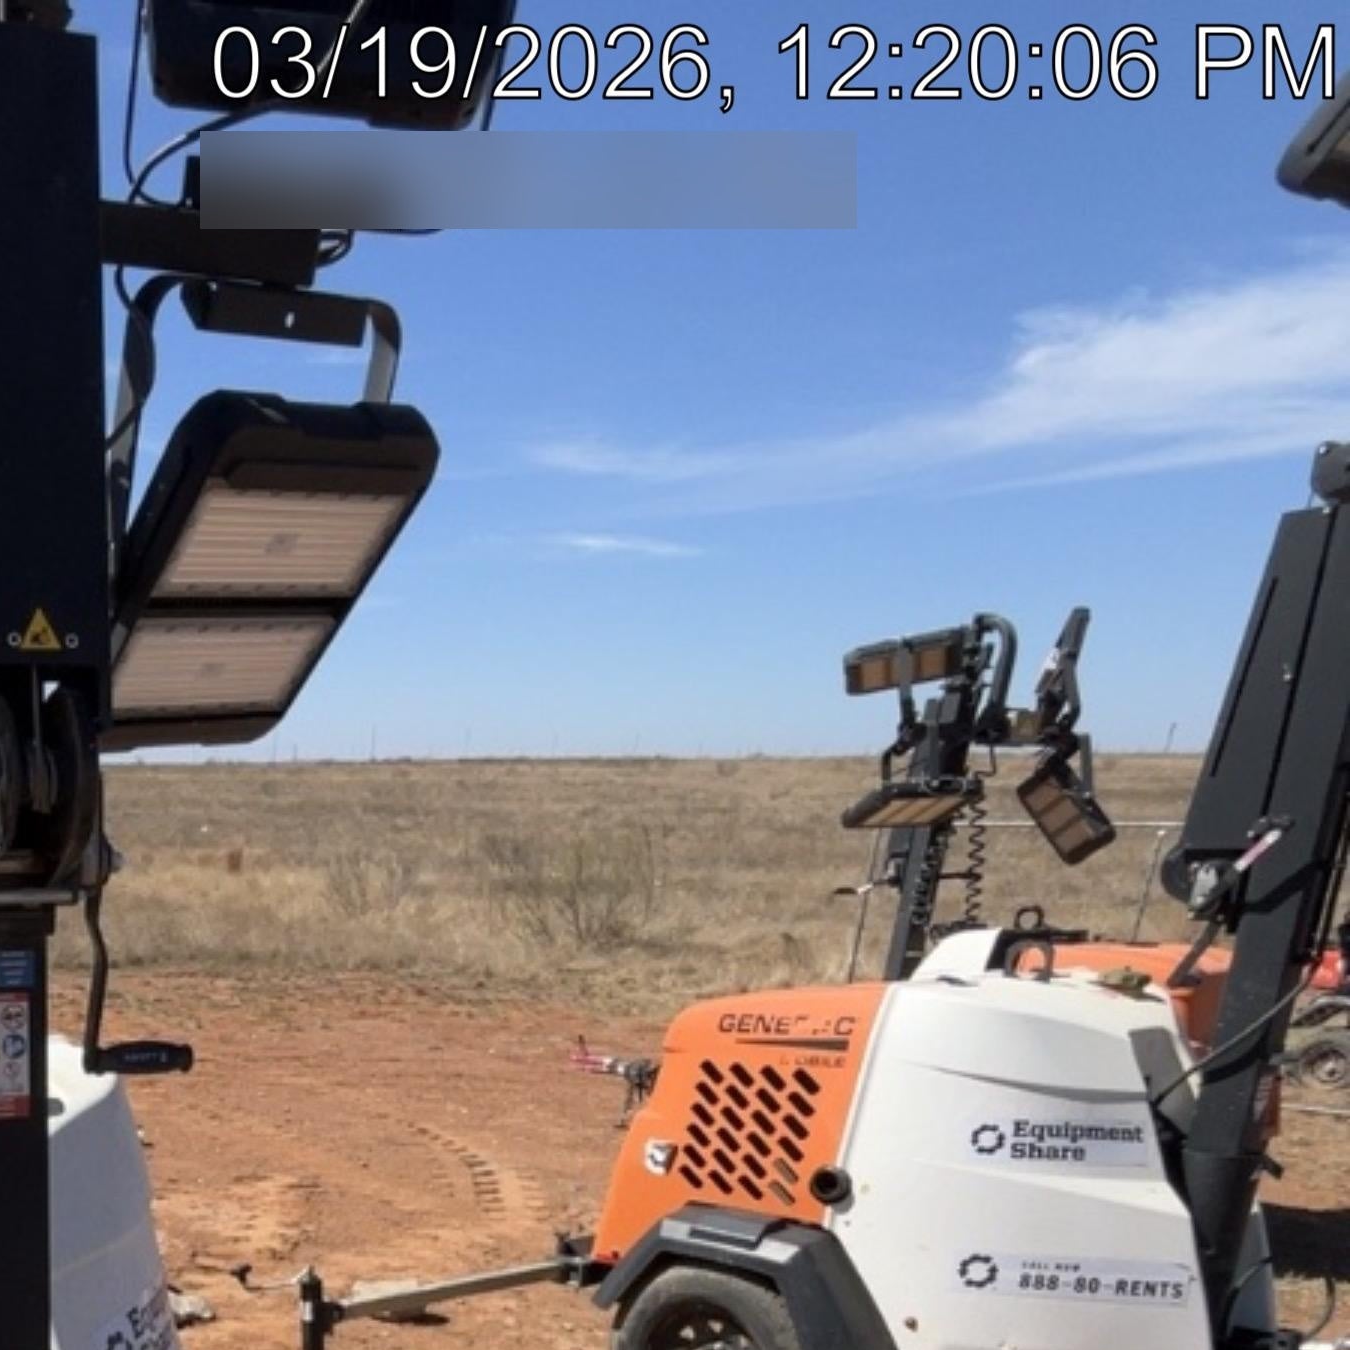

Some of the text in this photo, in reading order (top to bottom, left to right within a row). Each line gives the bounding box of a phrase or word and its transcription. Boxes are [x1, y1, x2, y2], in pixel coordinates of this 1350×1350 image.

[719, 1014, 856, 1036] GENEC
[1013, 1120, 1144, 1143] Equipment
[1010, 1142, 1087, 1161] Share
[1018, 1273, 1183, 1298] 888-80-RENTS
